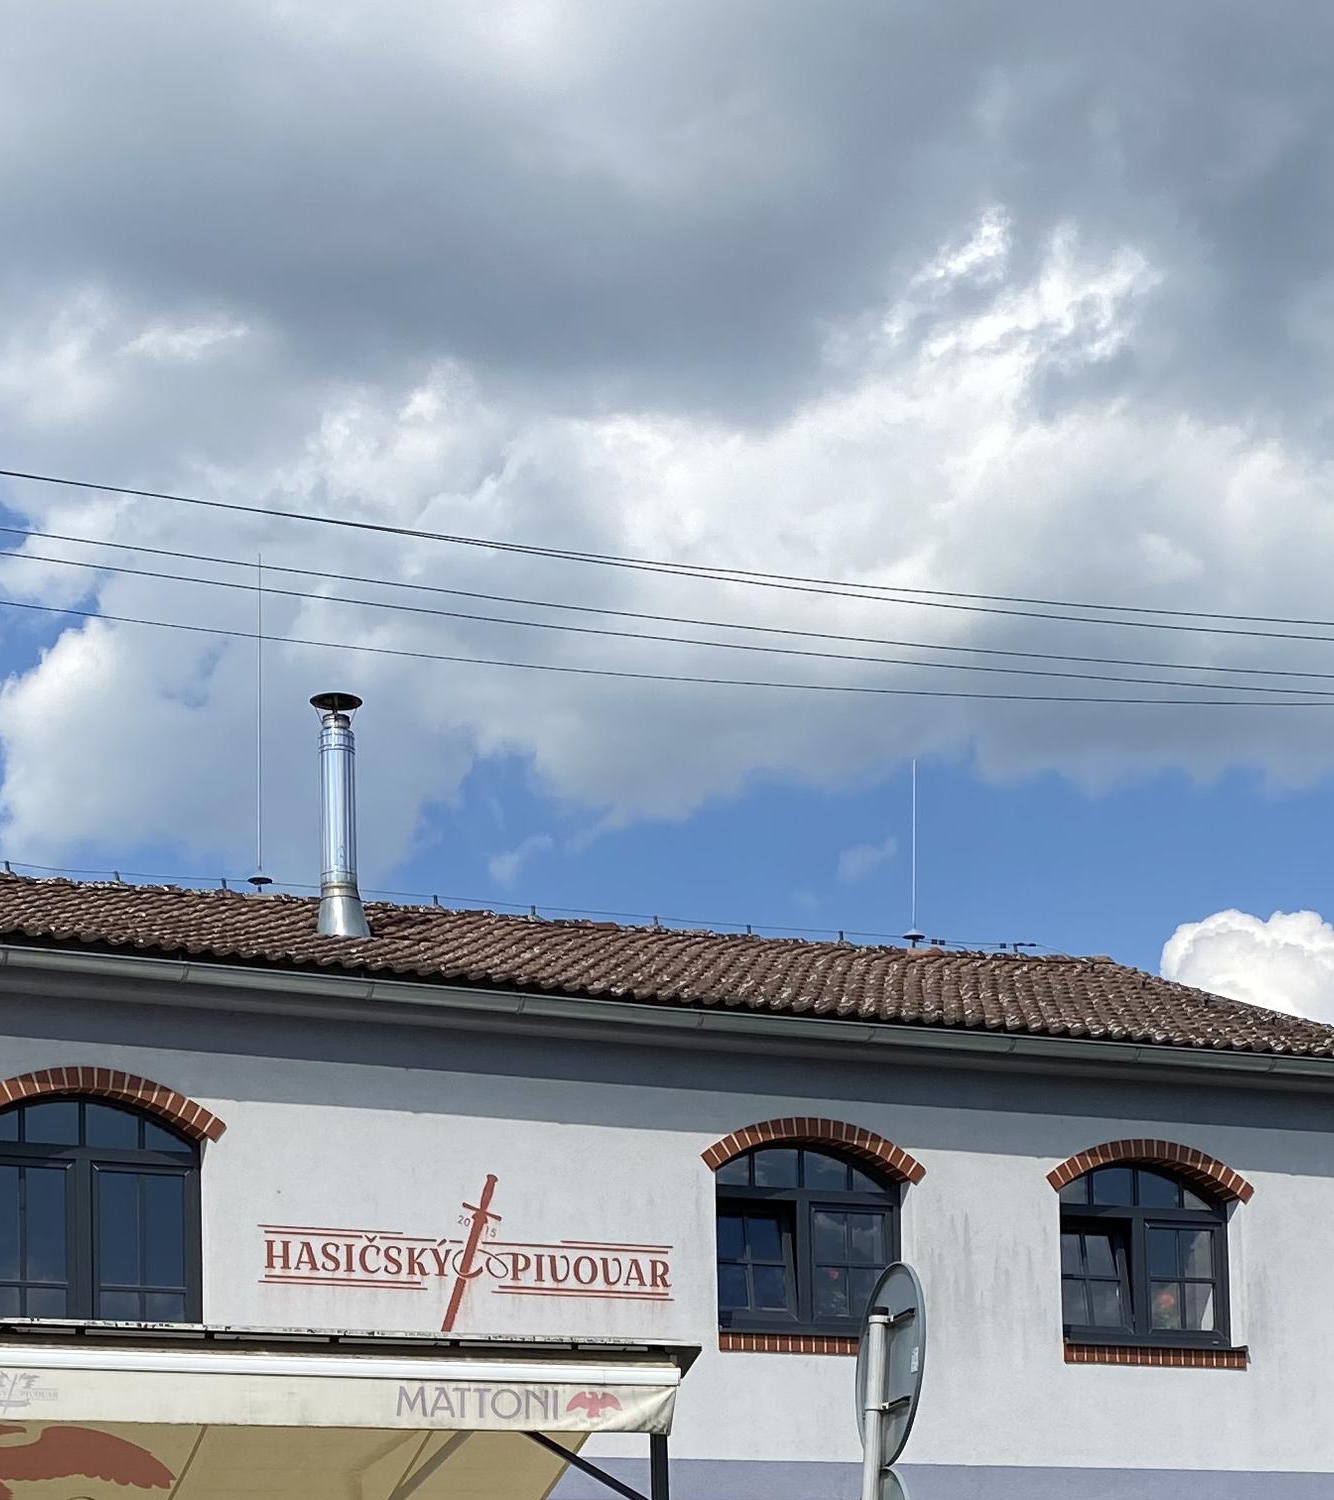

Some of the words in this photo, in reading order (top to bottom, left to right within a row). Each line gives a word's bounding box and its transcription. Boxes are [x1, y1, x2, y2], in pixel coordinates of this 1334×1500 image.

[457, 1214, 471, 1227] 20
[485, 1225, 498, 1238] 15
[263, 1234, 453, 1277] HASIČSKÝ
[508, 1252, 673, 1288] PIVOVAR
[396, 1385, 559, 1421] MATTONI
